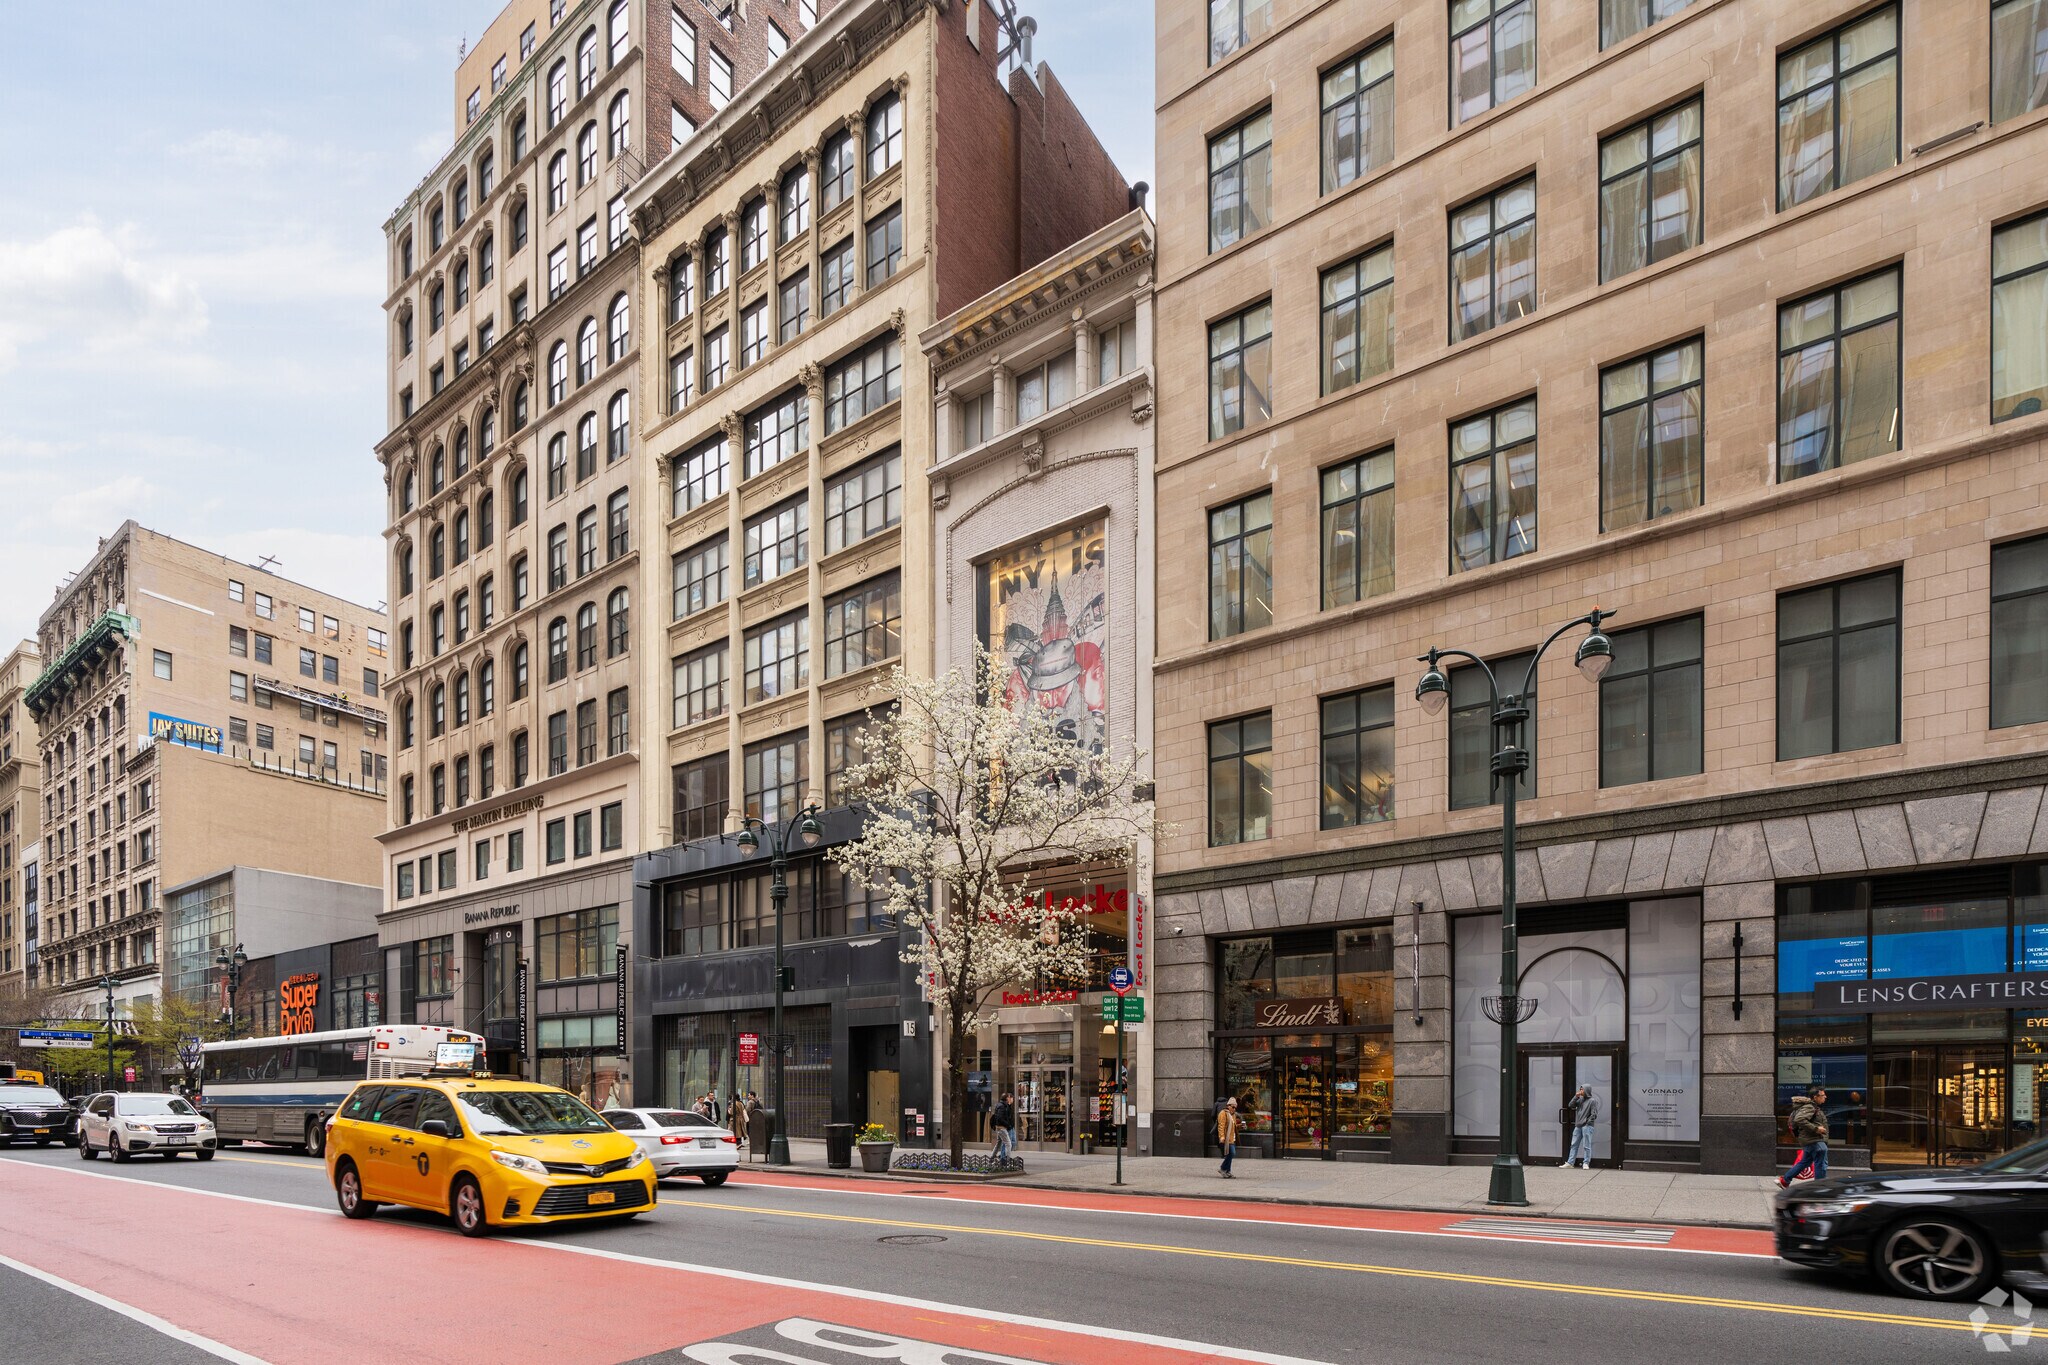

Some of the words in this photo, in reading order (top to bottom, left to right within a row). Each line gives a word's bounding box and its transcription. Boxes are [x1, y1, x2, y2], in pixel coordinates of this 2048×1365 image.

[999, 559, 1046, 604] NY
[152, 718, 172, 737] JAY
[175, 722, 219, 744] SUITES
[452, 819, 469, 833] THE
[469, 808, 502, 828] MARTIN
[503, 795, 544, 818] BUILDING
[465, 911, 489, 924] BANANA
[490, 904, 520, 919] REPUBLIC
[1046, 884, 1128, 922] Locke
[1135, 898, 1143, 949] Locker
[1135, 953, 1143, 987] Foot
[281, 981, 318, 1016] Super
[1002, 990, 1030, 1005] Foot
[906, 1022, 915, 1034] 15
[1256, 1003, 1323, 1027] Lindt
